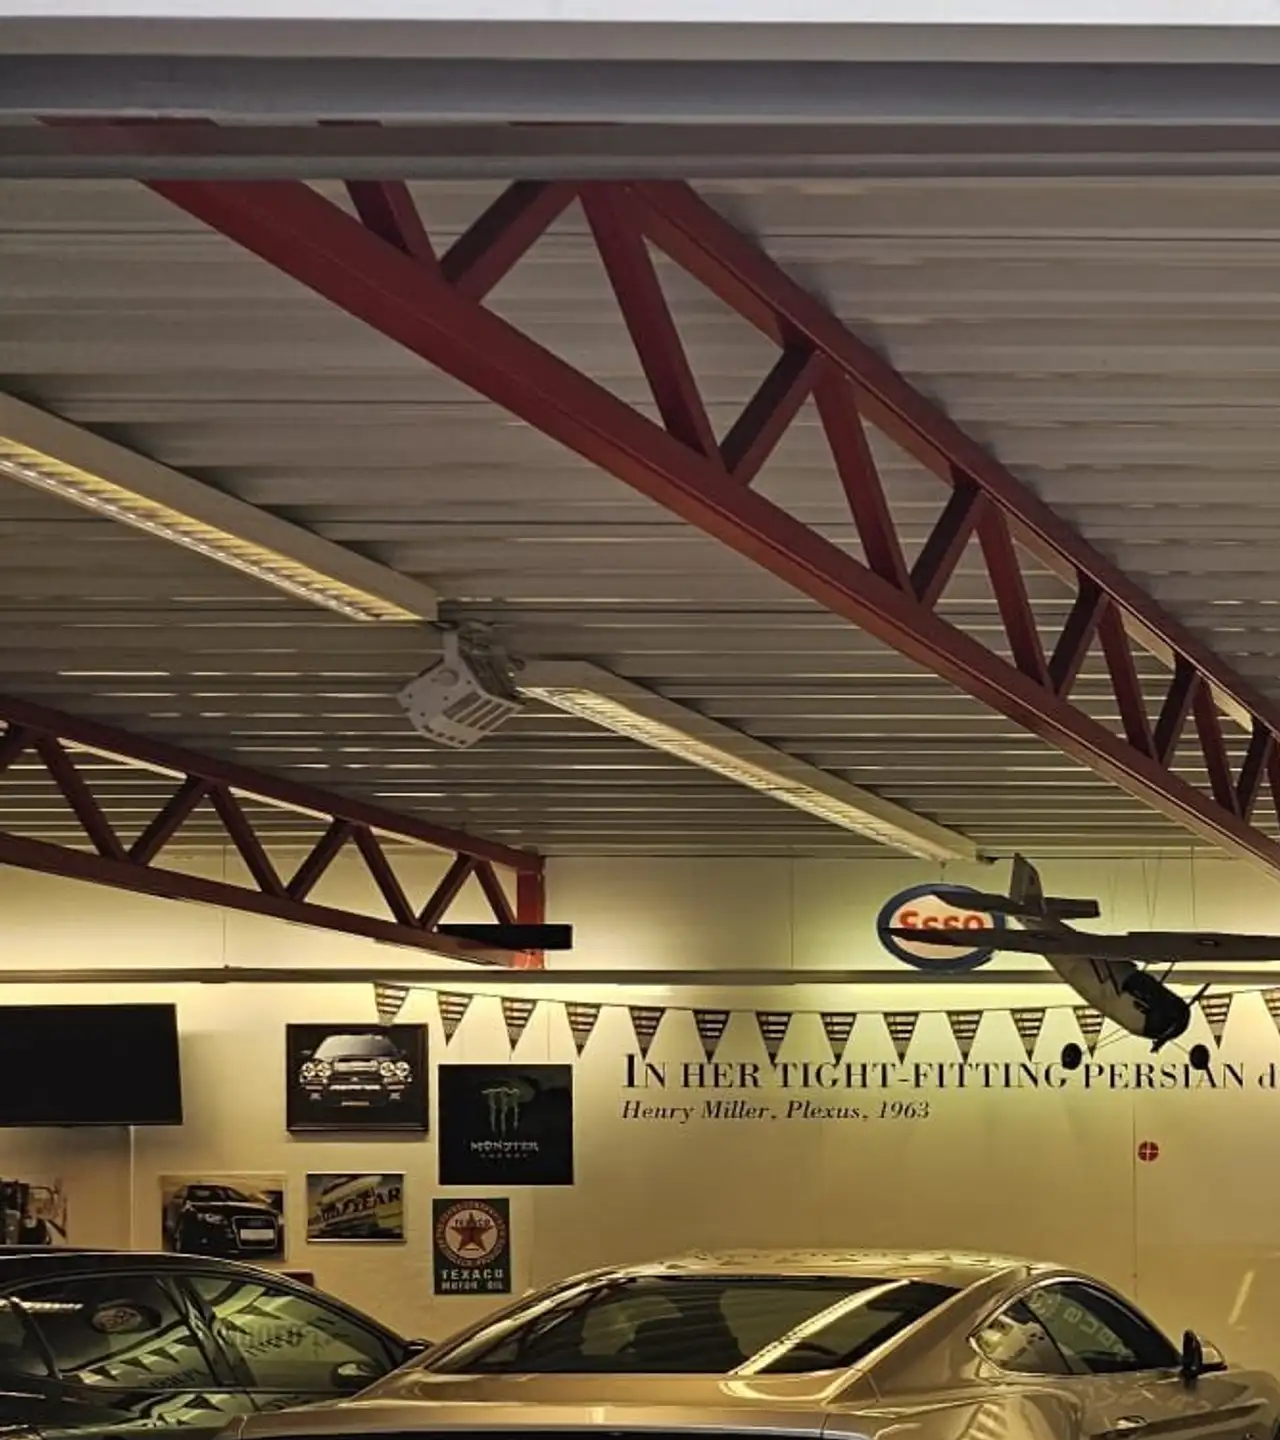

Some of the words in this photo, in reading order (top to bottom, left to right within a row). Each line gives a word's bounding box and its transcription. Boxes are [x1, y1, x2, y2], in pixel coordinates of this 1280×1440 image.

[680, 1062, 762, 1088] HER
[773, 1061, 1068, 1089] TIGHT-FITTING
[1083, 1062, 1245, 1089] PERSIAN
[621, 1100, 696, 1124] Henry
[701, 1099, 777, 1121] Miller,
[786, 1099, 869, 1121] Plexus,
[878, 1101, 932, 1120] 1963
[442, 1269, 504, 1280] TEXACO
